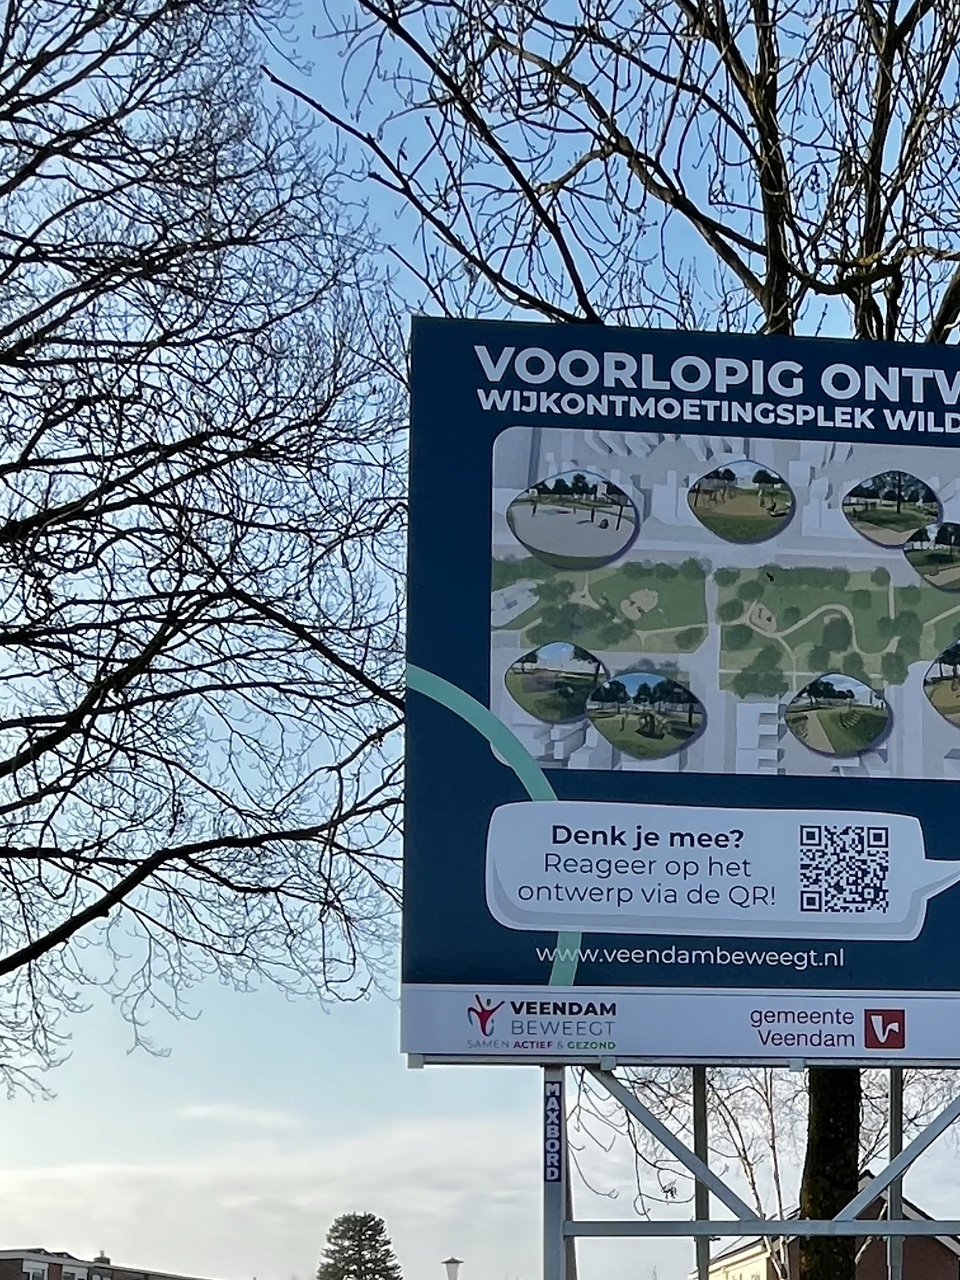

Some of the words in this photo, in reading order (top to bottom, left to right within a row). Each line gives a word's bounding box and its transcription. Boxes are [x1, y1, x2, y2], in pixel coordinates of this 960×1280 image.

[474, 345, 803, 397] VOORLOPIG
[477, 389, 875, 430] WIJKONTMOETINGSPLEK
[552, 825, 626, 847] Denk
[632, 826, 660, 850] je
[669, 828, 744, 849] mee?
[544, 853, 656, 878] Reageer
[665, 859, 699, 880] op
[708, 856, 751, 878] het
[517, 884, 633, 907] ontwerp
[641, 884, 677, 904] via
[687, 884, 720, 905] de
[728, 886, 776, 908] QR!
[536, 944, 846, 970] www.veendambeweegt.nl
[510, 1001, 617, 1016] VEENDAM
[750, 1009, 855, 1028] gemeente
[511, 1020, 615, 1036] BEWEEGT
[758, 1029, 855, 1047] Veendam
[467, 1039, 509, 1049] SAMEN
[513, 1040, 553, 1050] ACTIEF
[557, 1041, 563, 1049] &
[567, 1041, 616, 1050] GEZOND
[546, 1083, 560, 1180] MAXBORD
